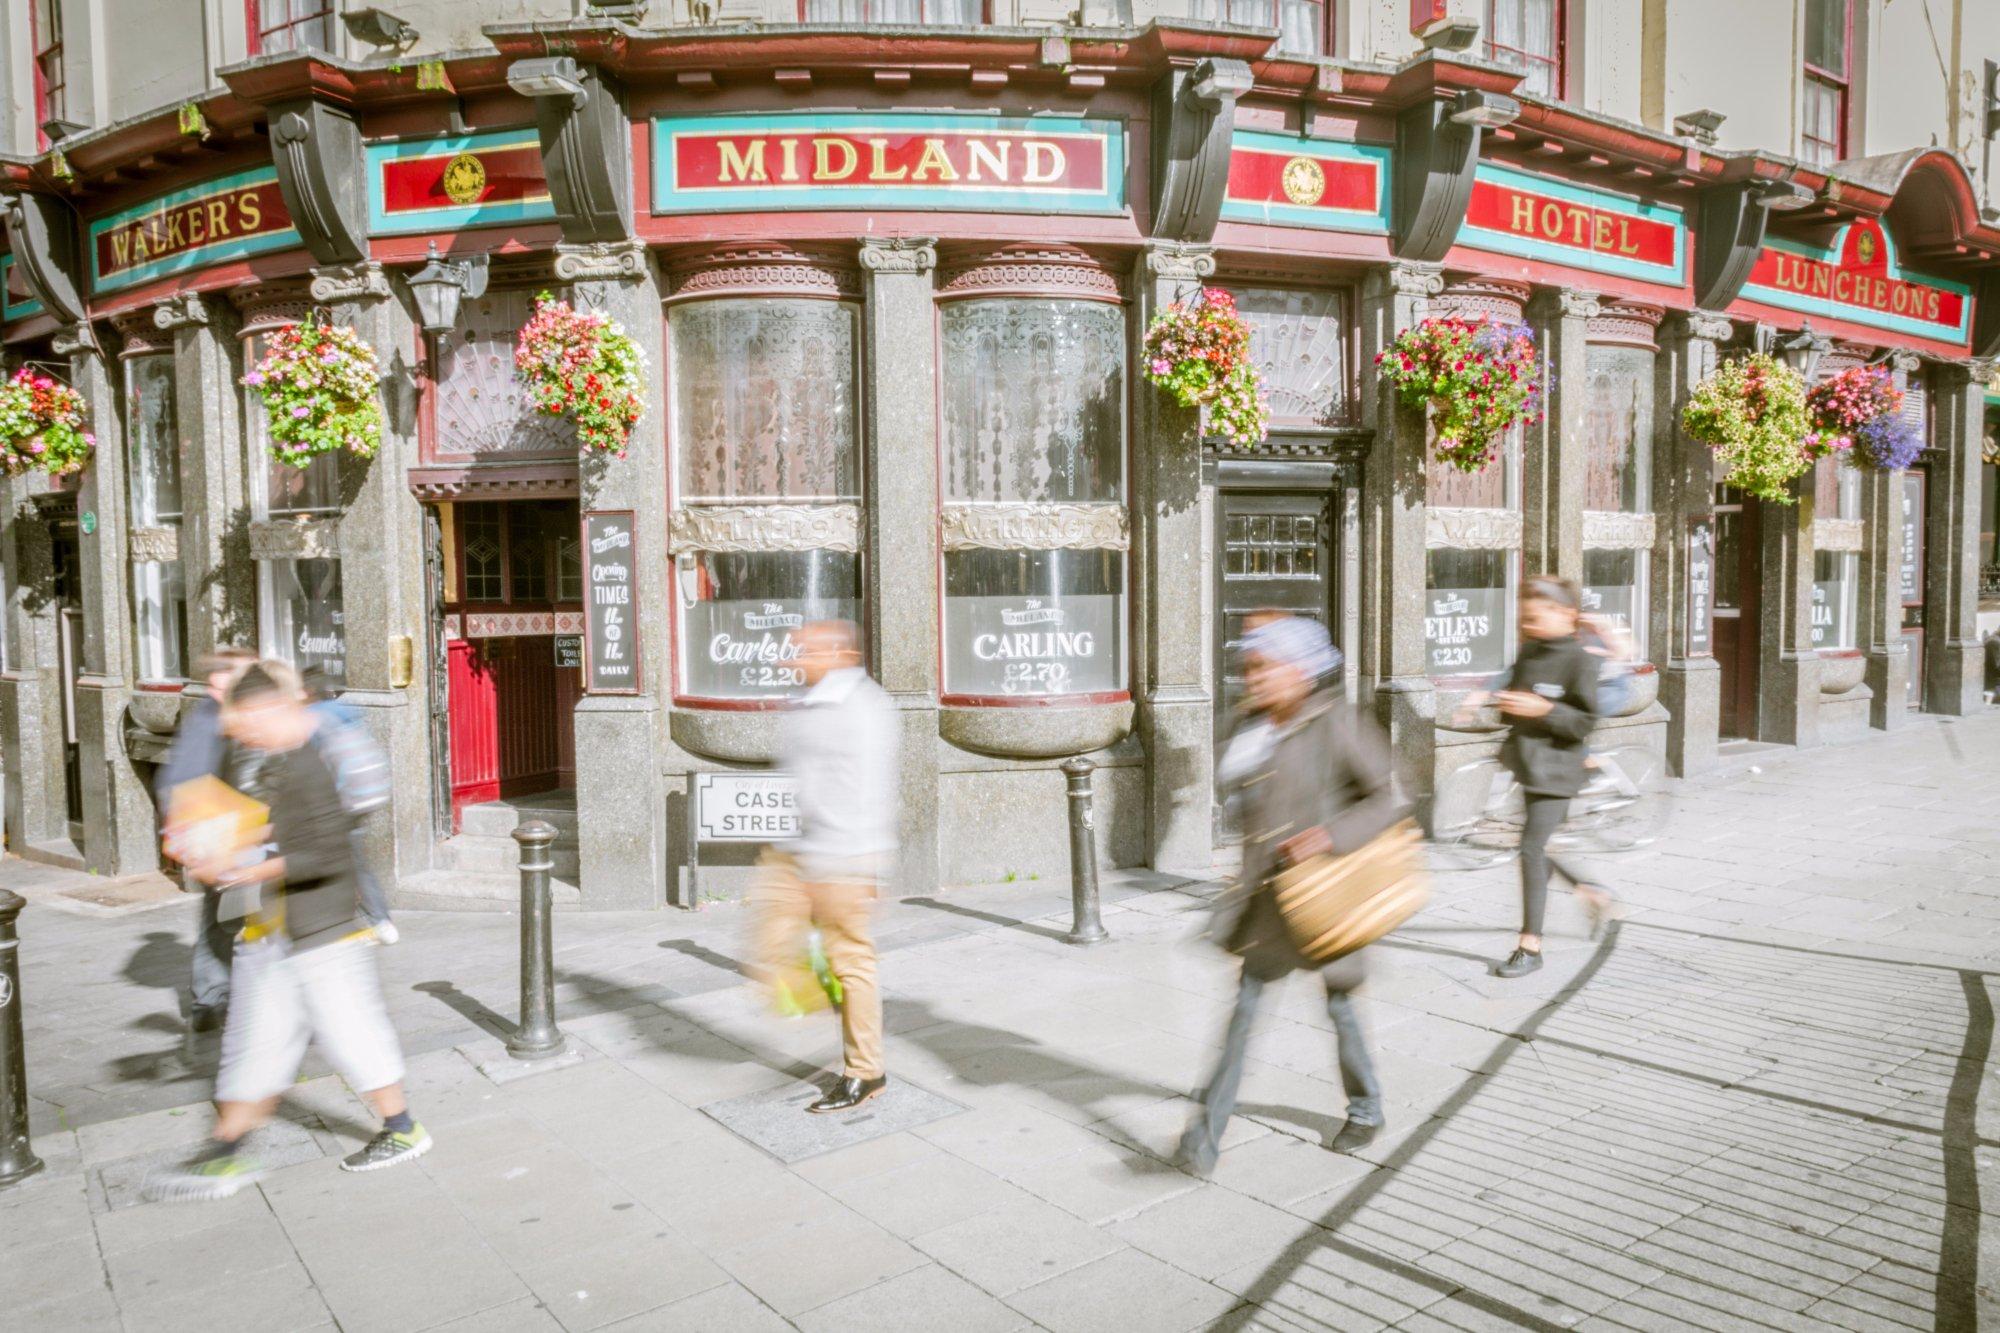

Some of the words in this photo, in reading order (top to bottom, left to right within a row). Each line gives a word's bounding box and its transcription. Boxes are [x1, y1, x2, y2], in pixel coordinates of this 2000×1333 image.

[716, 138, 1067, 184] MIDLAND
[111, 192, 262, 266] WALKER'S
[1511, 194, 1640, 255] HOTEL
[1775, 255, 1941, 320] LUNCHEONS
[594, 585, 629, 605] TIMES
[1424, 615, 1490, 638] ETLEYS
[973, 631, 1095, 661] CARLING
[599, 665, 630, 676] DAILY
[740, 666, 807, 686] £2.20
[1004, 662, 1067, 682] £2.70
[722, 814, 801, 831] STREET
